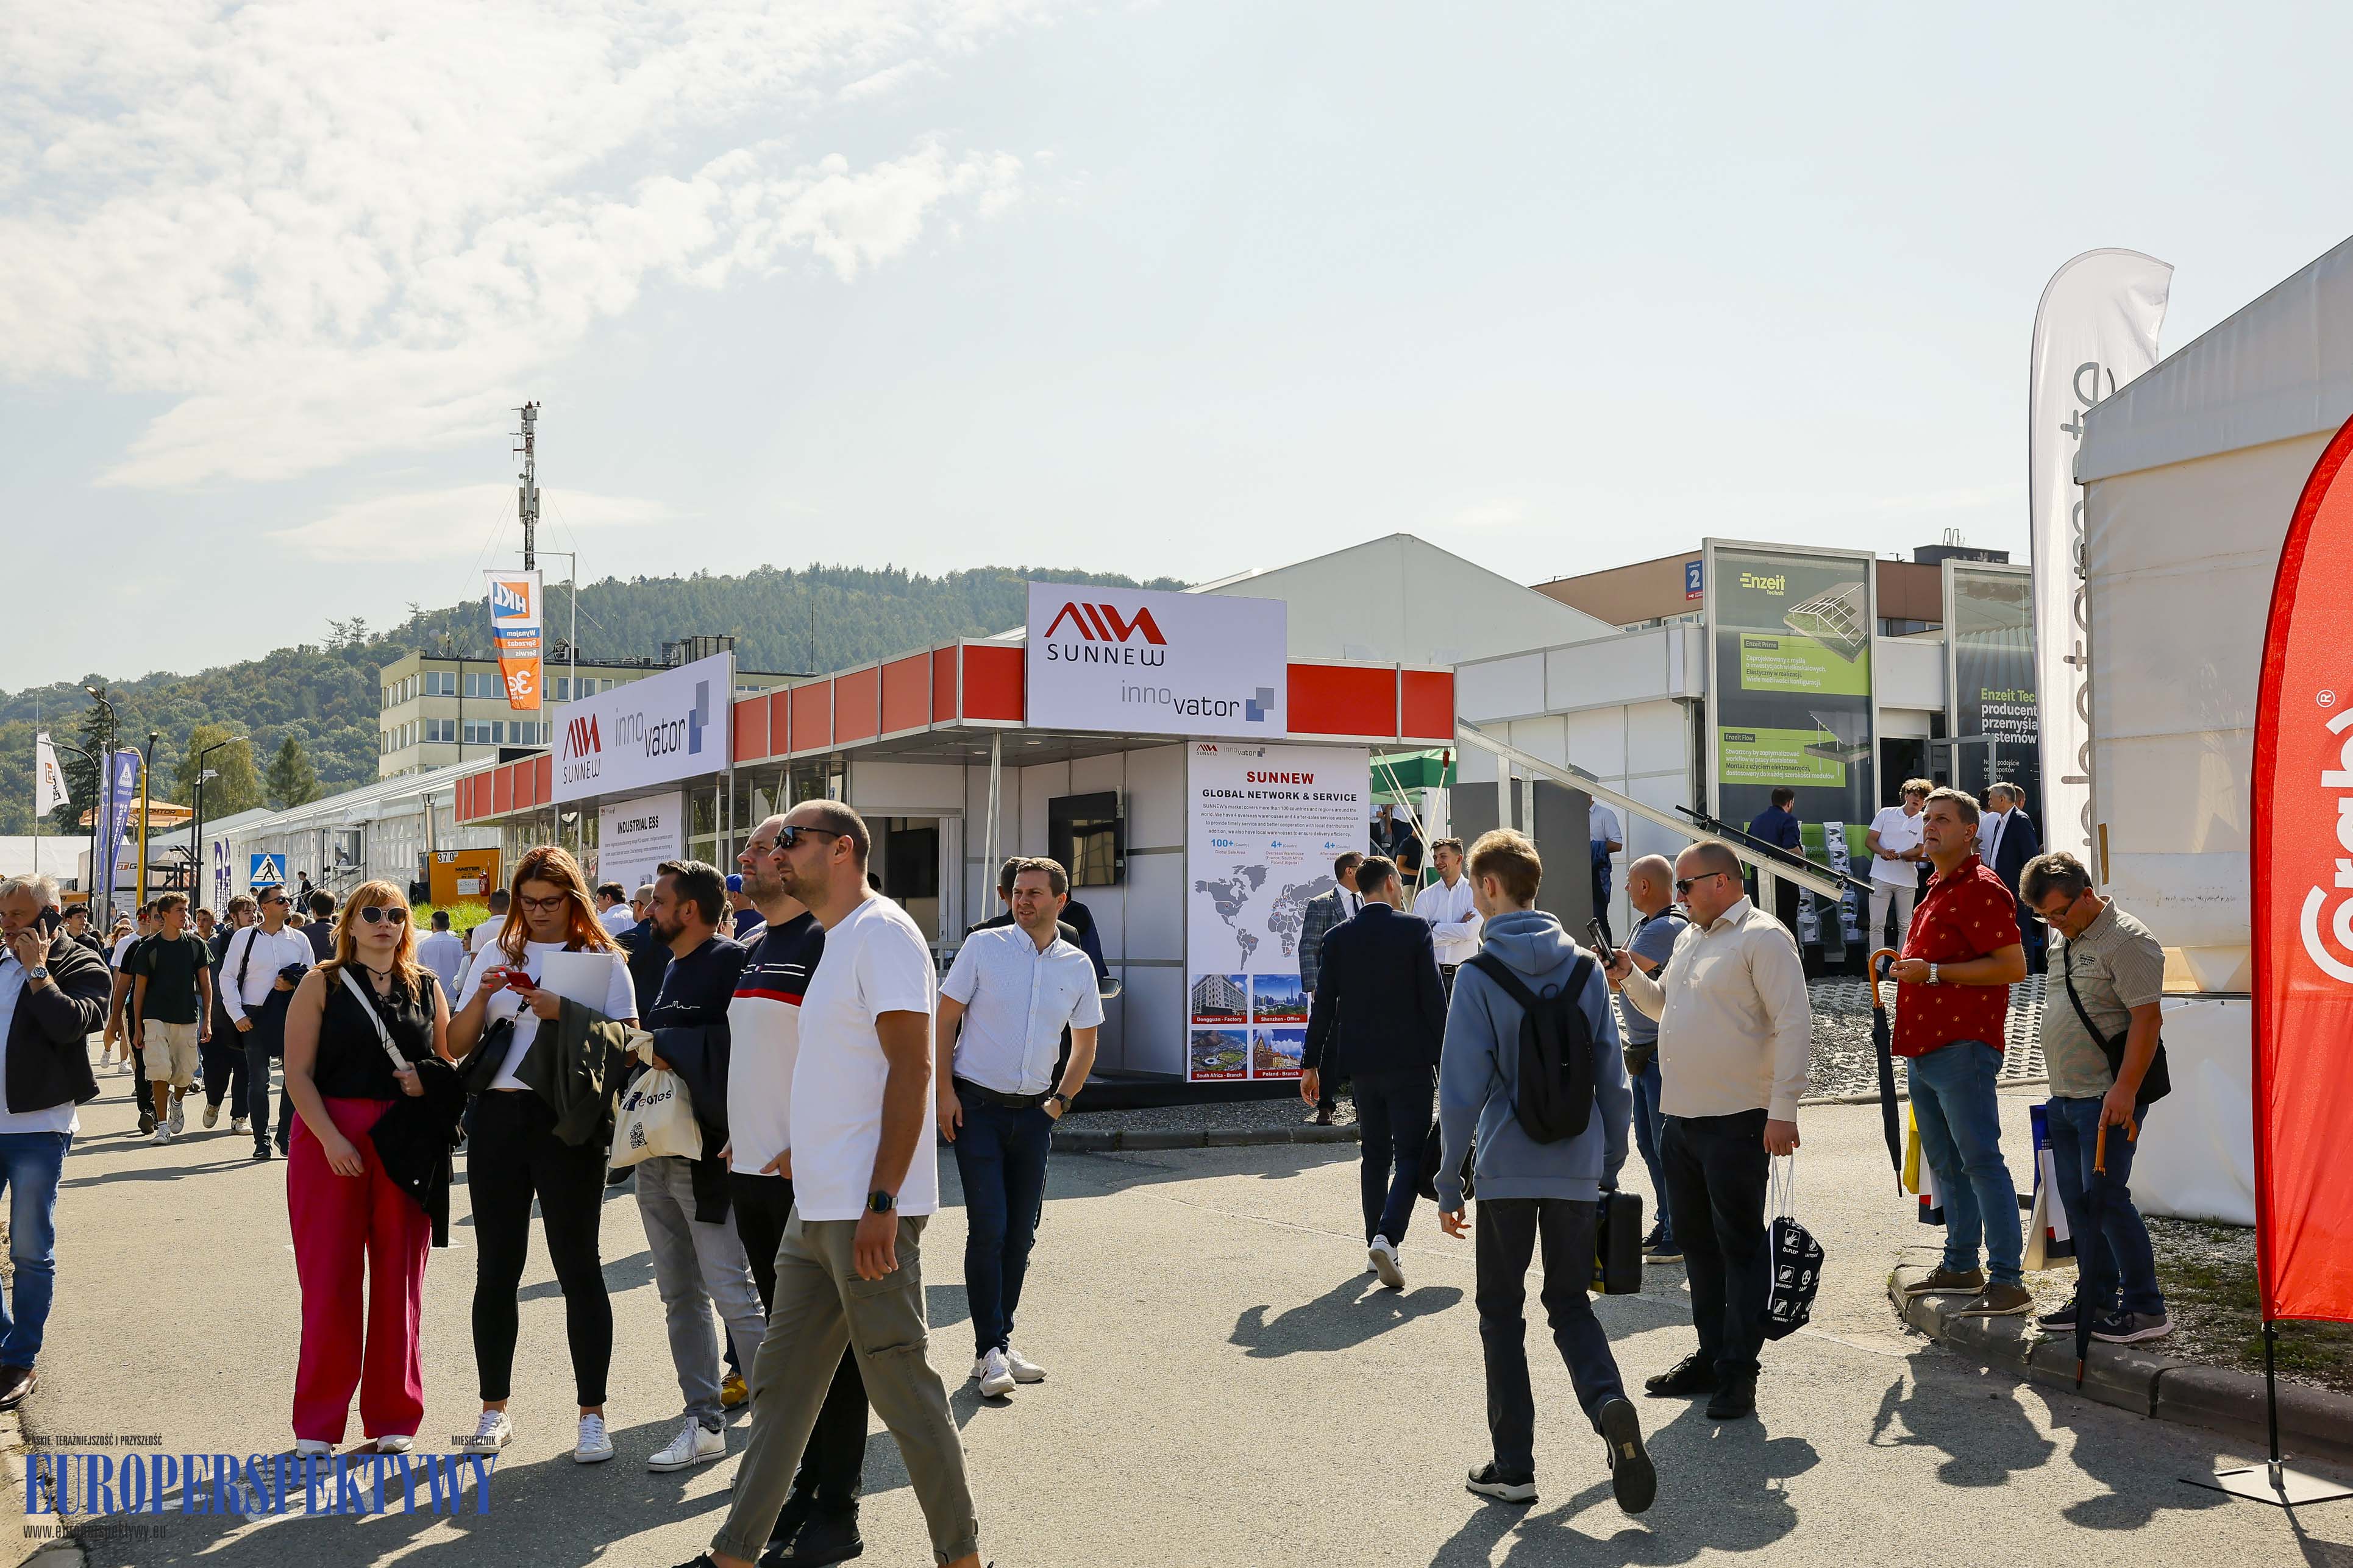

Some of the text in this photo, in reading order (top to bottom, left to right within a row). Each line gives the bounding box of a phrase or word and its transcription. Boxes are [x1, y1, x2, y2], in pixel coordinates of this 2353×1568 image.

[1690, 569, 1700, 588] 2
[1740, 572, 1785, 591] Enzeit
[1047, 644, 1165, 667] SUNNEW
[1746, 655, 1787, 664] Zaprojektowany
[1981, 687, 2037, 703] Enzeit Tec
[1981, 703, 2037, 717] producent
[1982, 716, 2038, 733] przemyśla
[1982, 730, 2037, 745] stemów
[1726, 748, 1752, 757] Stworzony
[1998, 759, 2020, 768] podejście
[563, 758, 600, 785] SUNNEW
[1247, 772, 1314, 785] SUNNEW
[1202, 789, 1245, 798] GLOBAL
[1248, 790, 1300, 800] NETWORK
[1313, 792, 1357, 801] SERVICE
[618, 815, 659, 834] INDUSTRIAL ESS
[1211, 839, 1234, 847] 100+
[438, 852, 454, 862] 370
